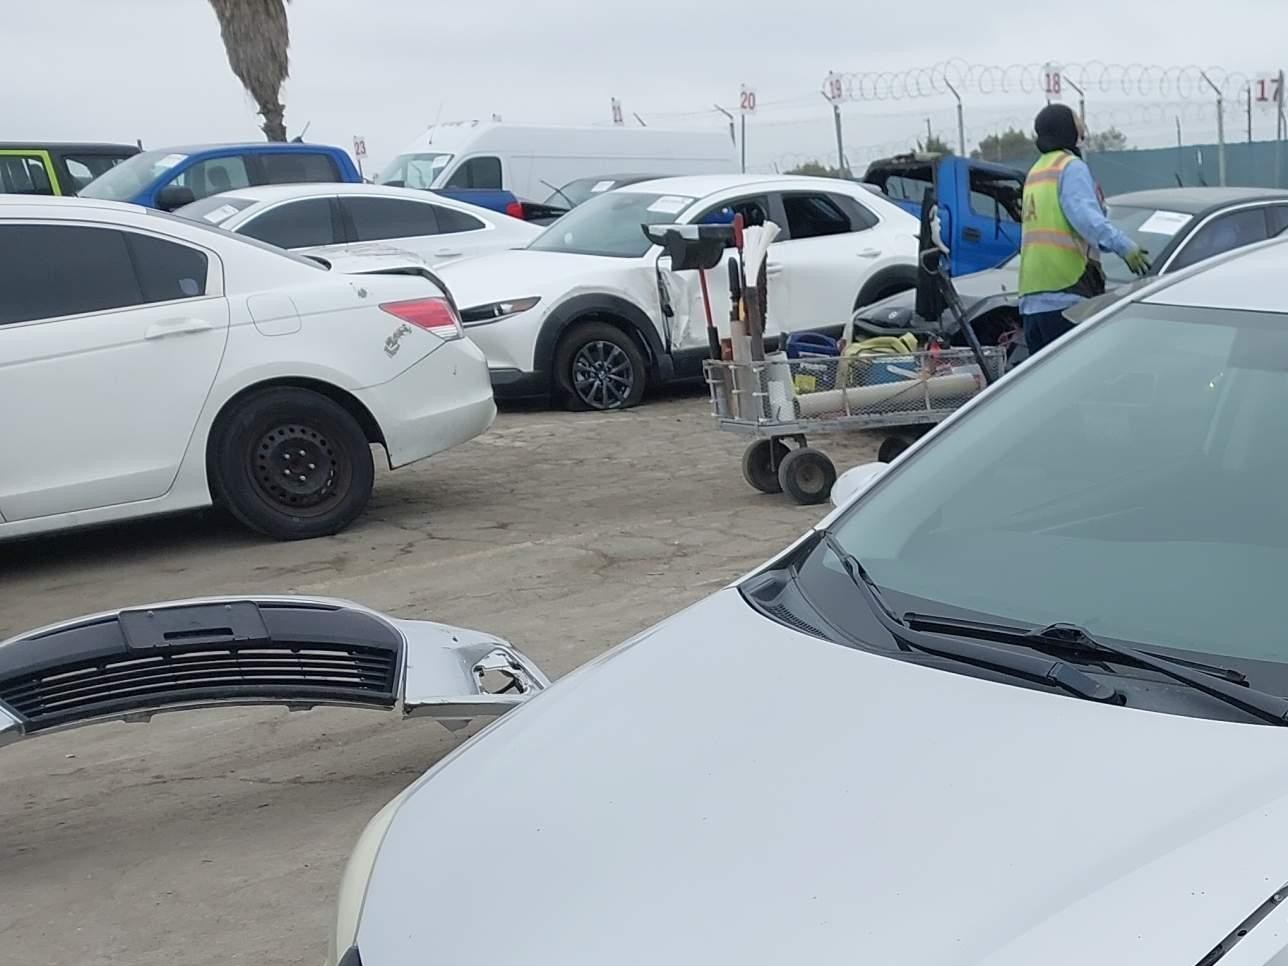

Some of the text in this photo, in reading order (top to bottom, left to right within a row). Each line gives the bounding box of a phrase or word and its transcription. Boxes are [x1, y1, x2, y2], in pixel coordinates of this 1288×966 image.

[1045, 72, 1061, 94] 18
[1256, 79, 1283, 102] 17
[740, 91, 756, 110] 20
[354, 140, 366, 155] 23
